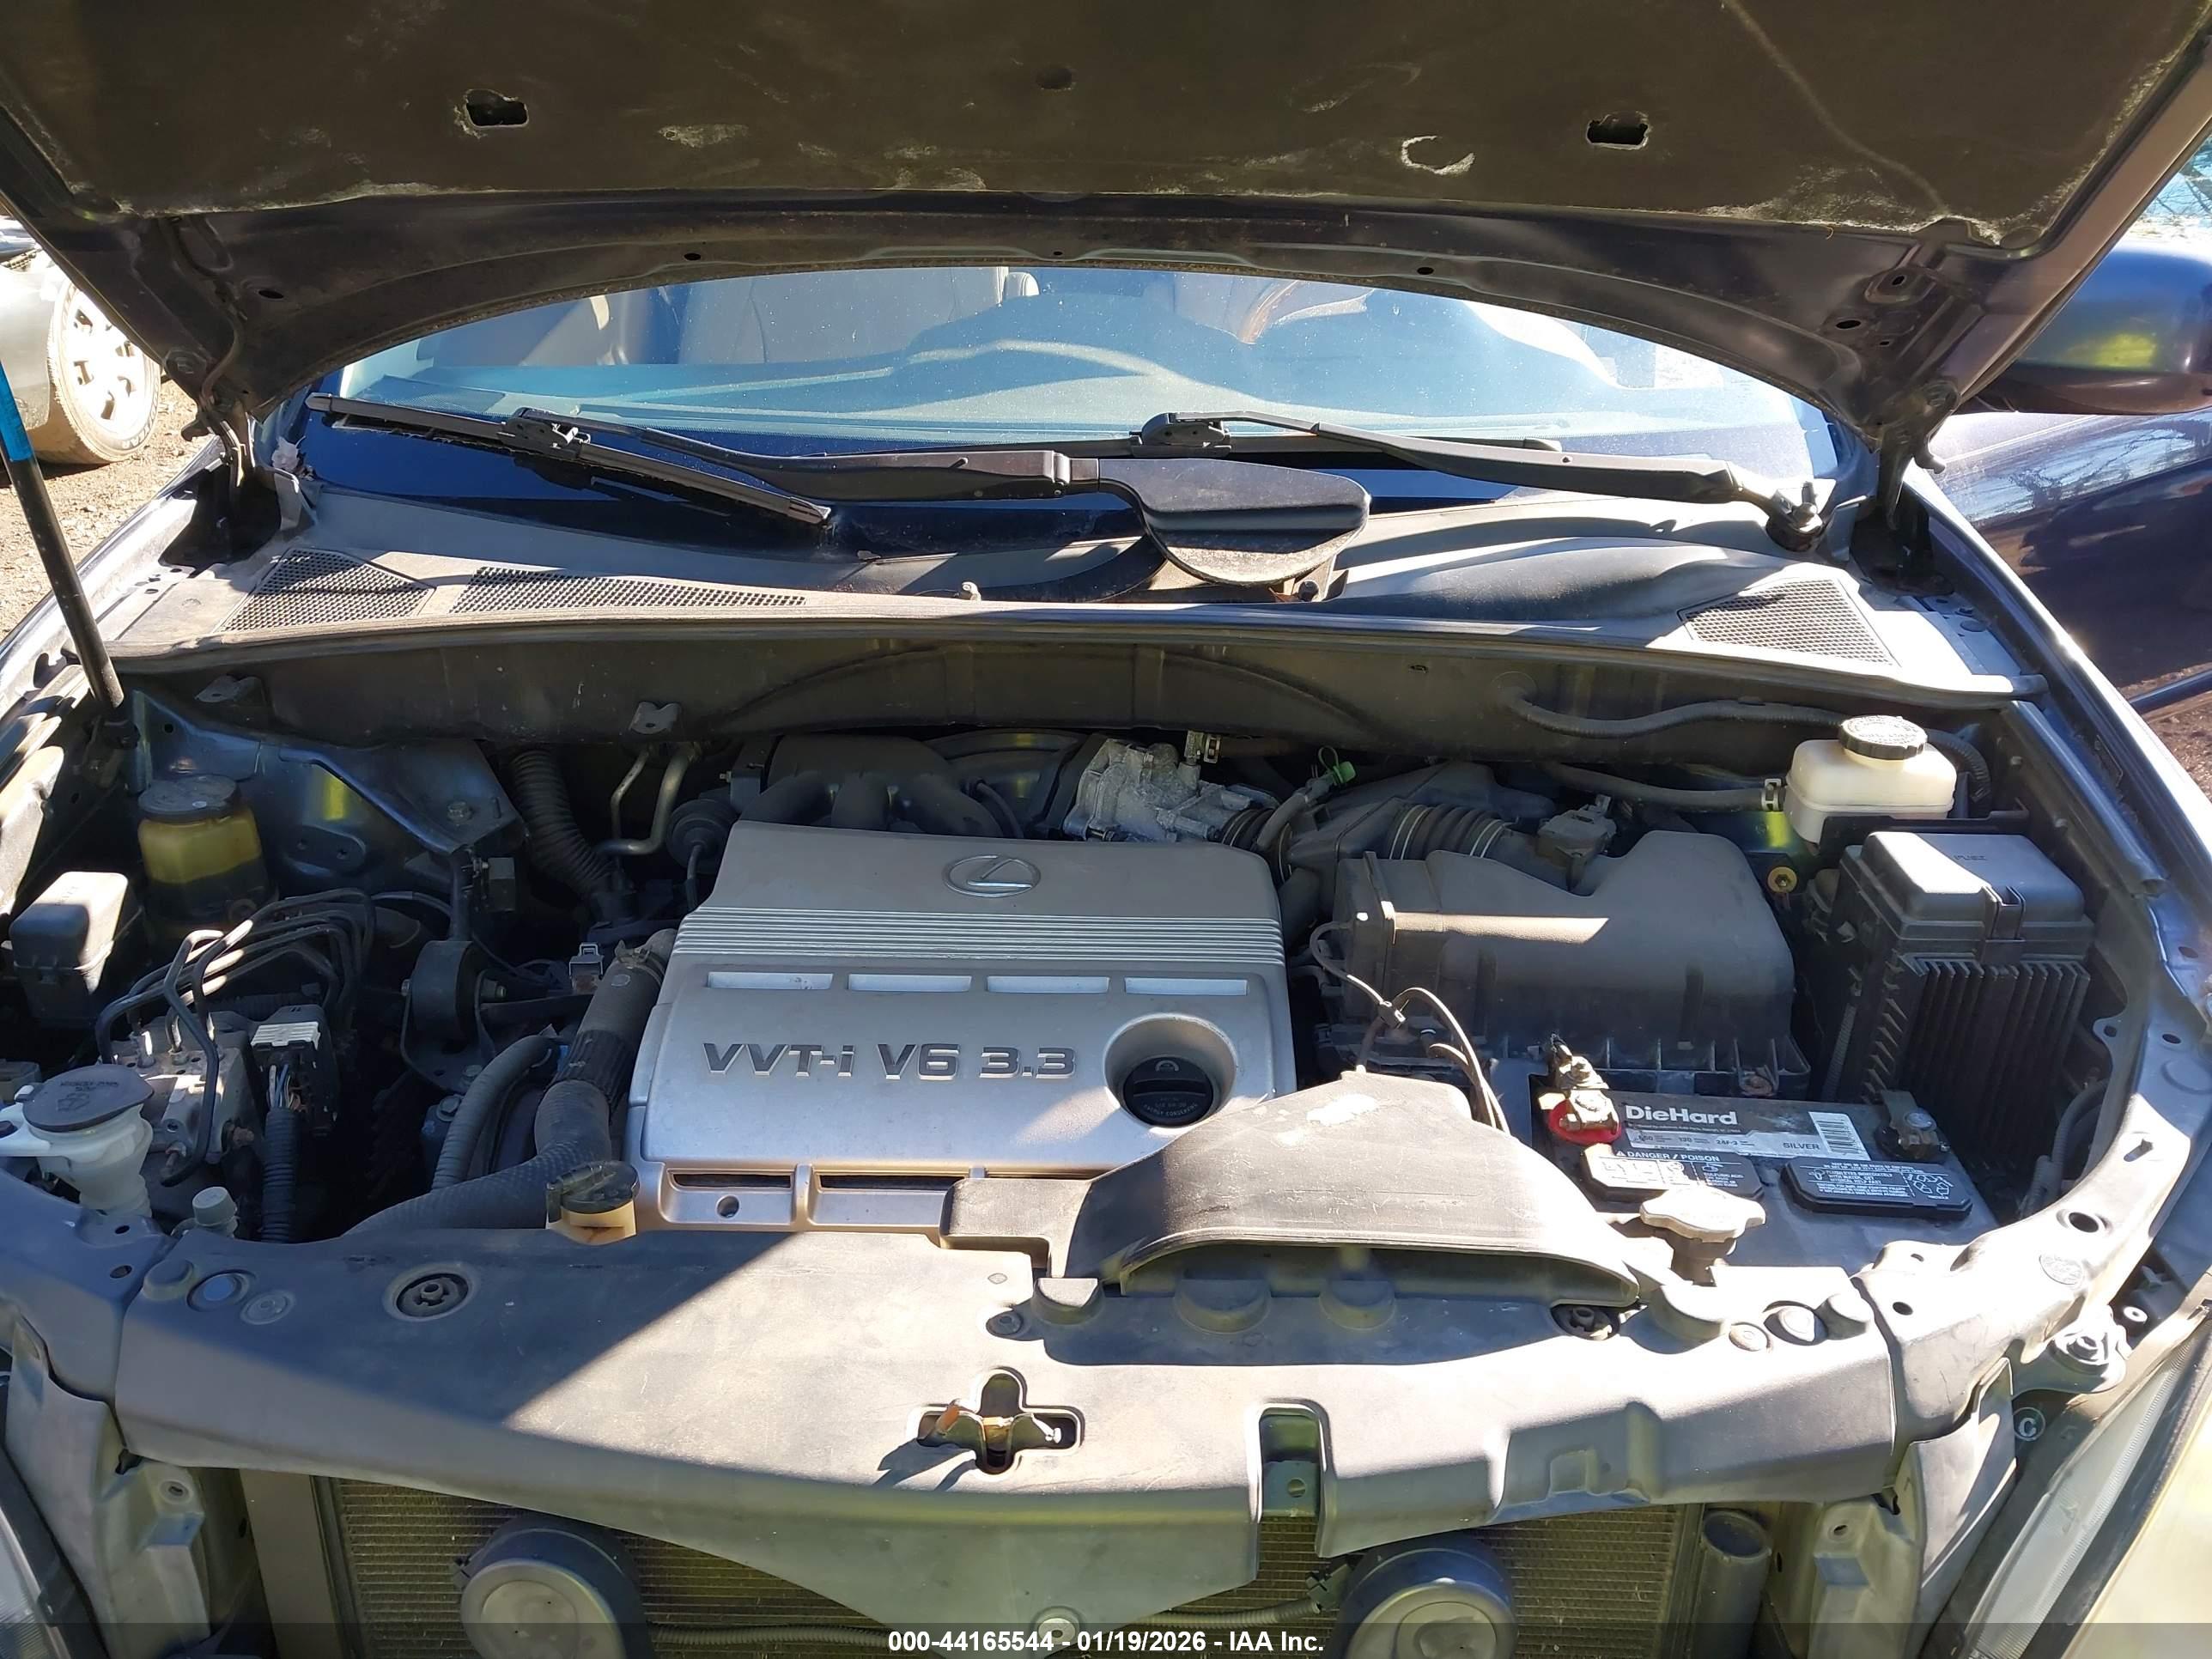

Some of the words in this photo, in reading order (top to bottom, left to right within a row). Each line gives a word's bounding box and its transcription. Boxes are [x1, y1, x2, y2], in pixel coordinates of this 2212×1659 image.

[703, 1042, 854, 1077] VVT-i
[876, 1043, 961, 1081] V6
[979, 1046, 1077, 1079] 3.3
[1626, 1105, 1738, 1125] DieHard
[1626, 1151, 1670, 1159] DANGER
[1680, 1154, 1721, 1163] POISON
